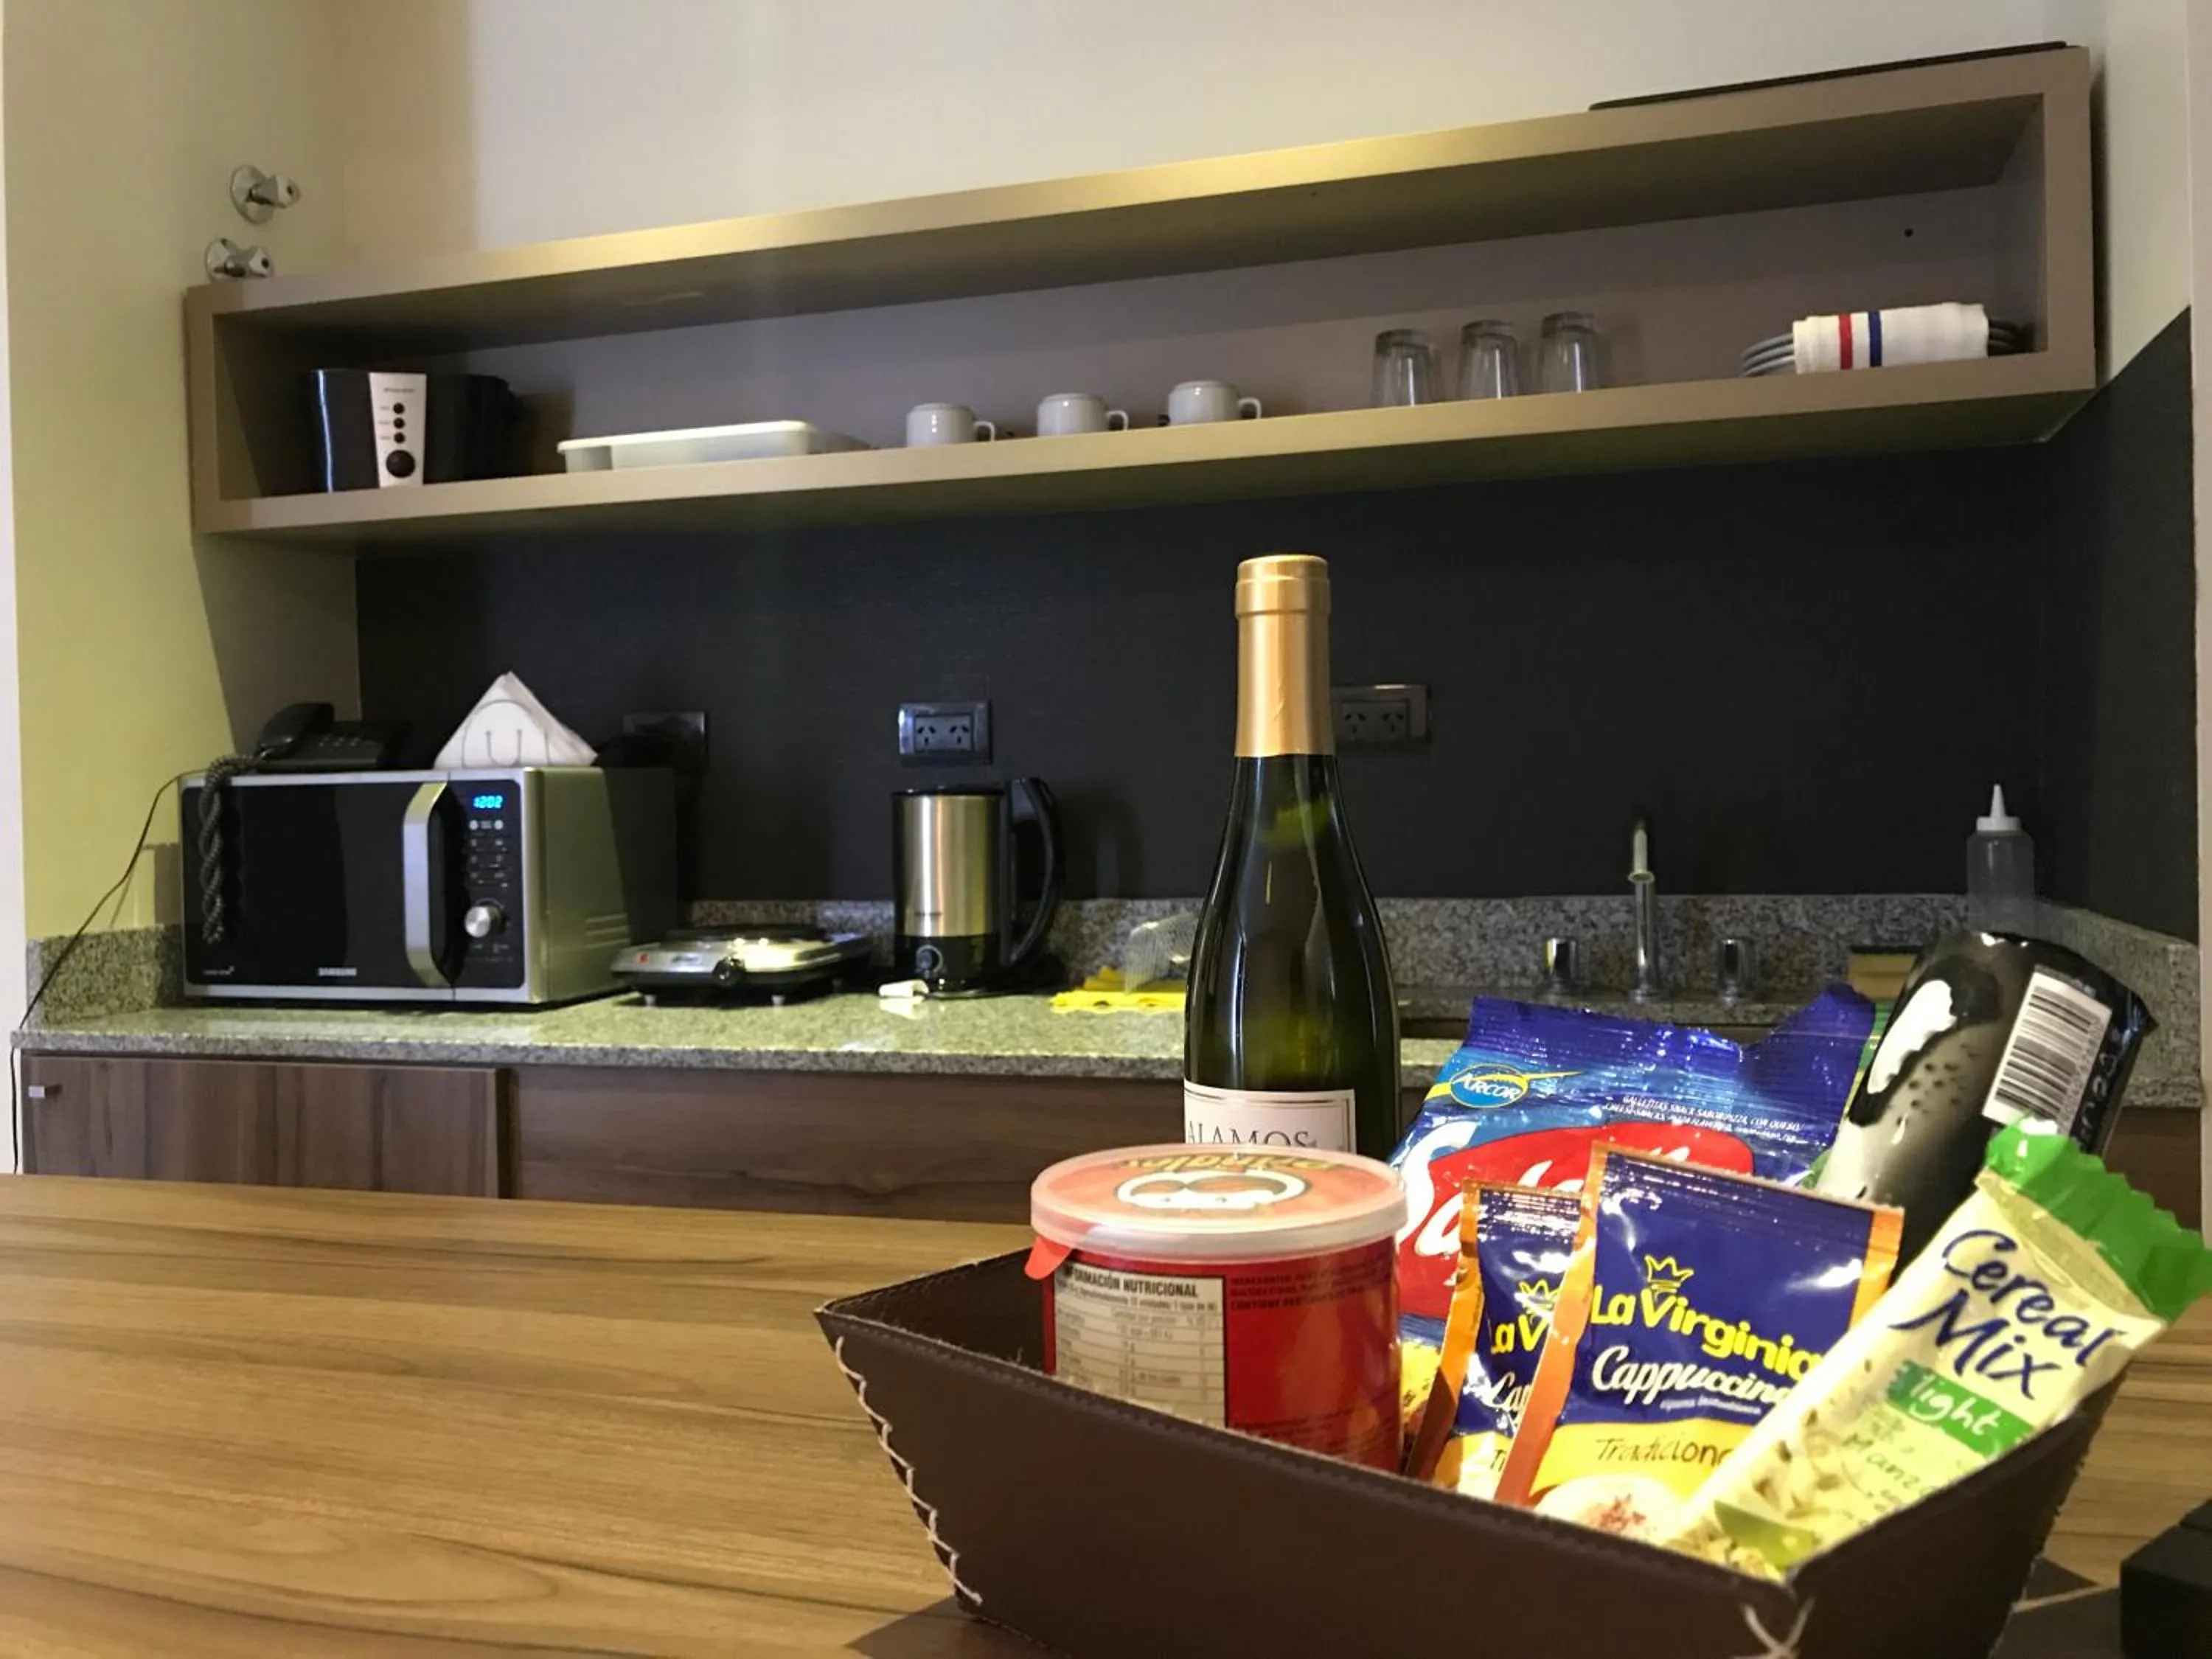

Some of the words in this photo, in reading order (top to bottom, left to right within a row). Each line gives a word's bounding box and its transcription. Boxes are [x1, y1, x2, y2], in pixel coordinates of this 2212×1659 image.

[1452, 1073, 1522, 1100] ARCOR
[1123, 1278, 1198, 1298] NUTRICIONAL
[1590, 1284, 1636, 1326] La
[1941, 1230, 2128, 1366] Cereal
[1489, 1322, 1516, 1354] a
[1887, 1287, 2062, 1400] Mix
